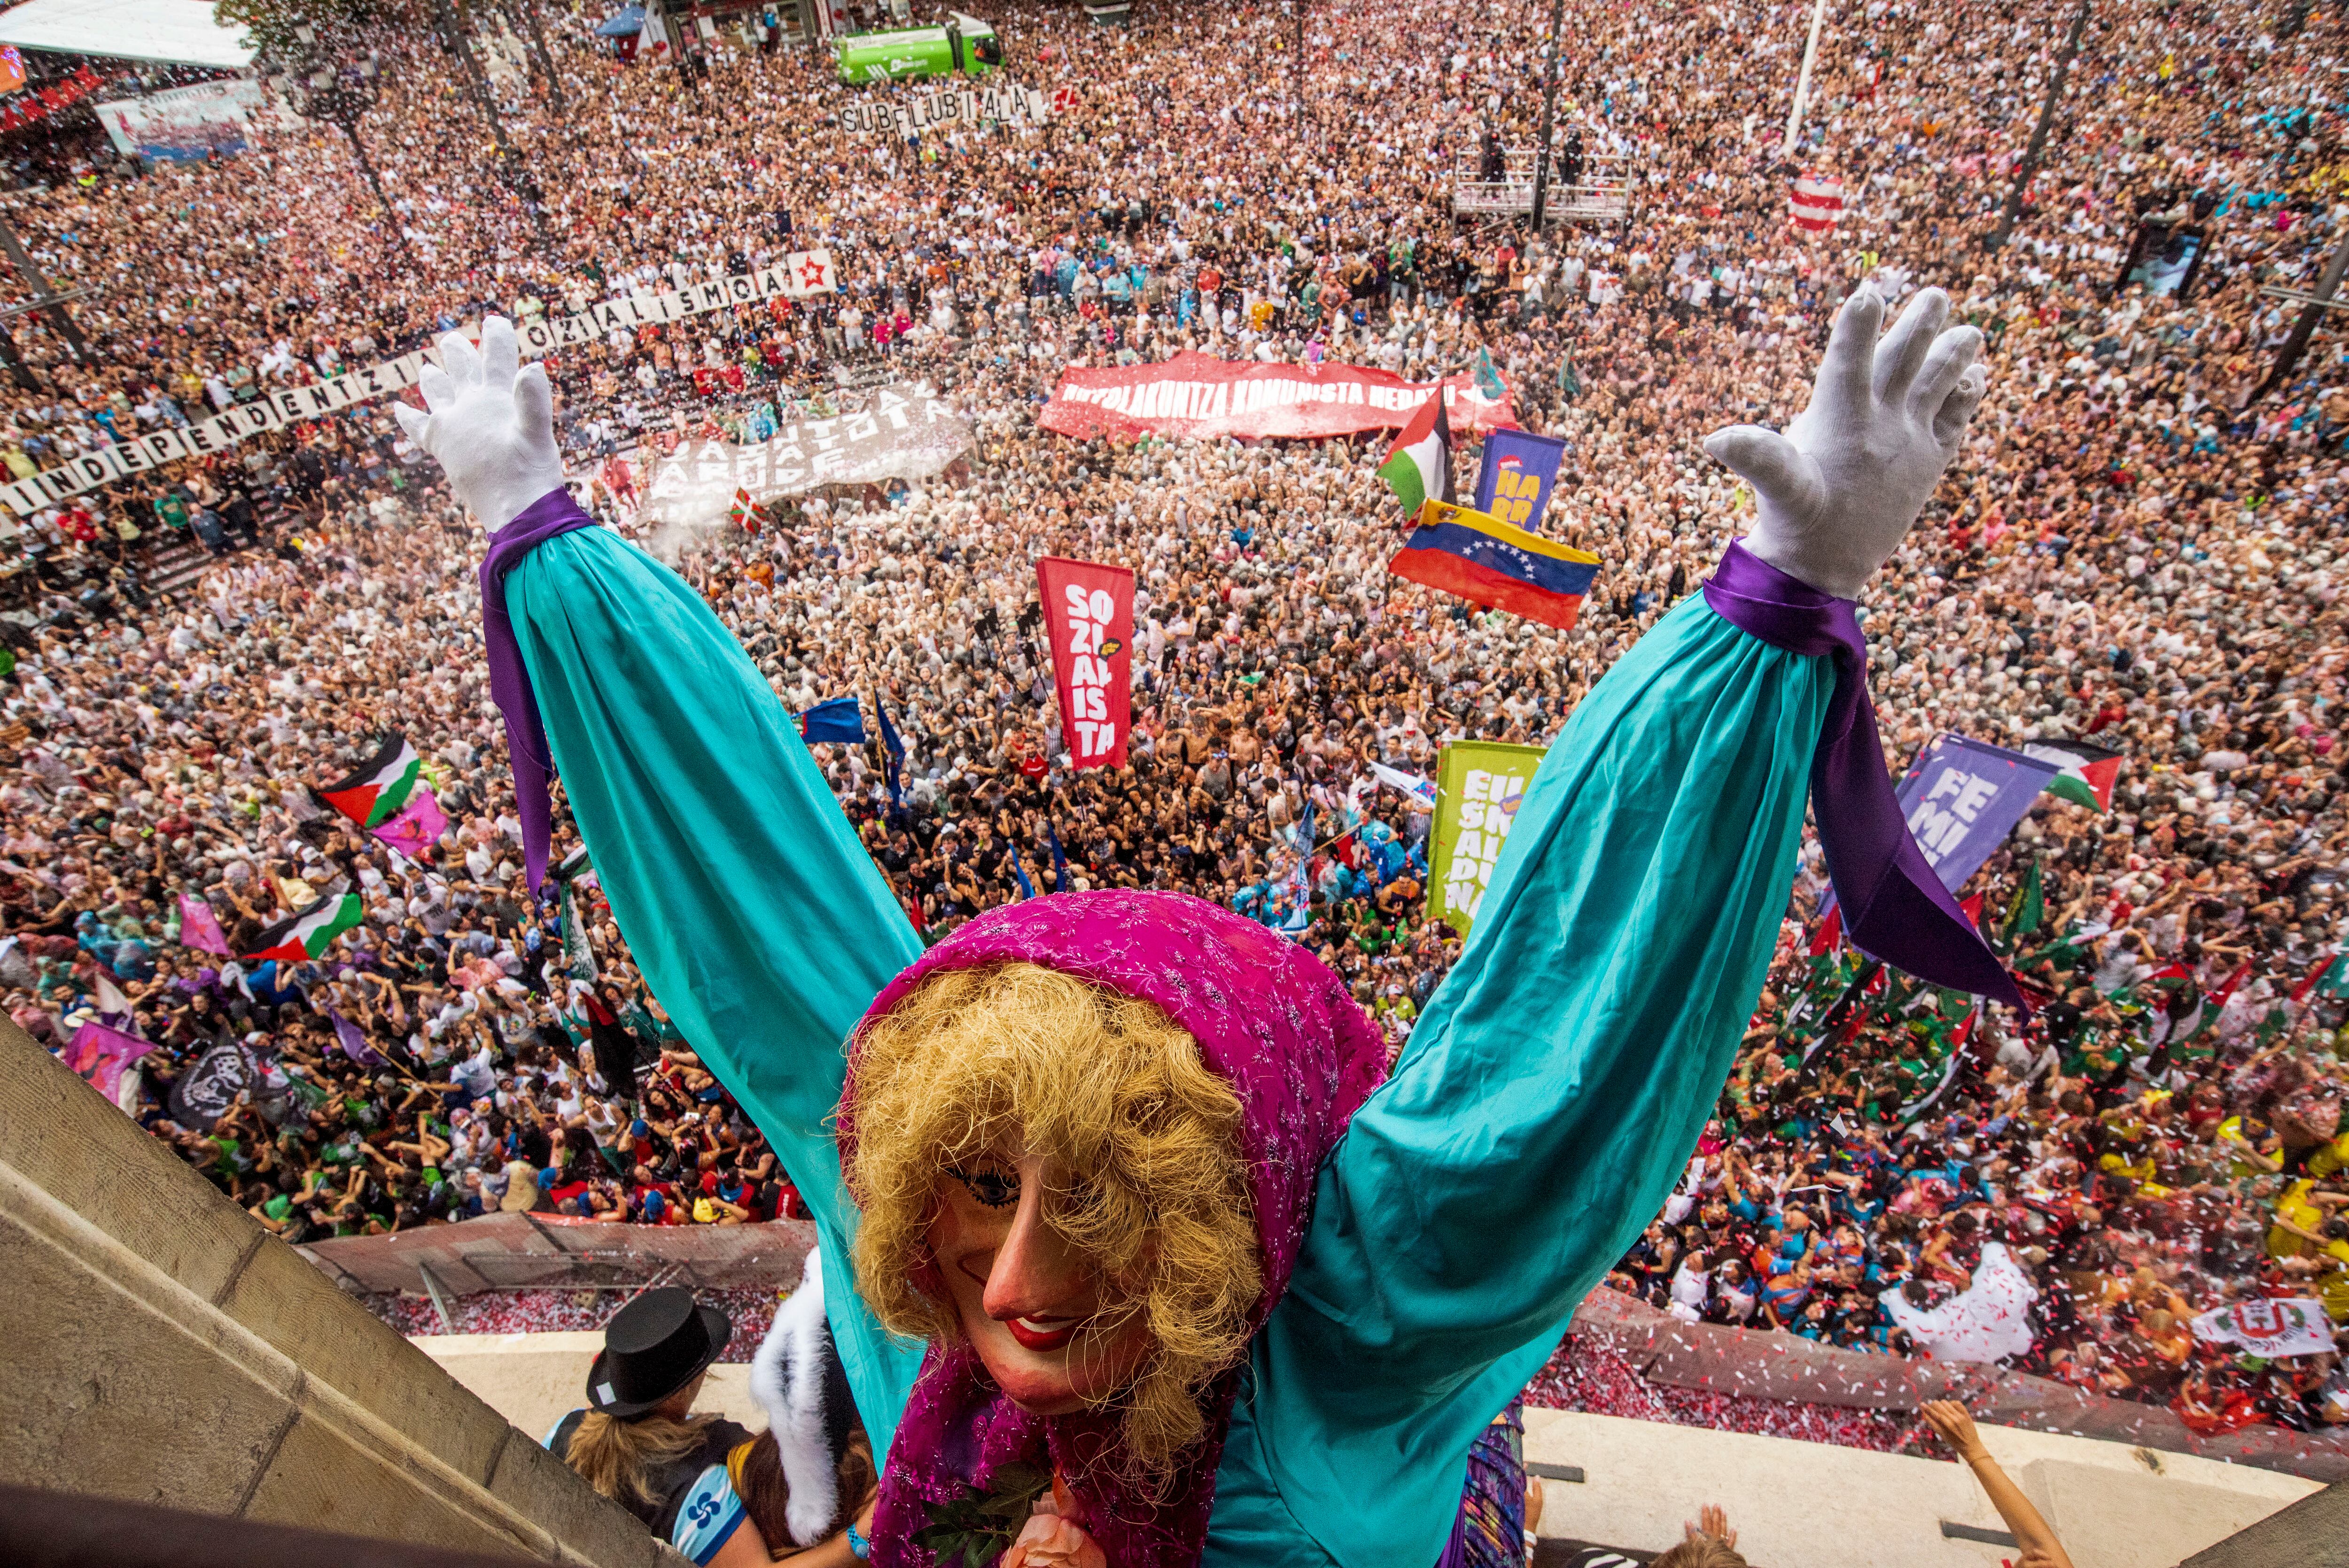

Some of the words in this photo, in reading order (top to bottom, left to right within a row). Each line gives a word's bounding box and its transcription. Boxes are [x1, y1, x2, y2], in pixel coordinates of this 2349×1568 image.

[518, 273, 782, 353] OZIALISMOA
[1230, 379, 1364, 416] KOMUNISTA
[1495, 470, 1540, 501] HA
[1066, 584, 1114, 625] SO
[1069, 620, 1104, 655] ZI
[1073, 687, 1107, 721] IS
[1074, 720, 1115, 758] TA
[1927, 767, 1999, 823] FE
[1907, 801, 1969, 857] MI
